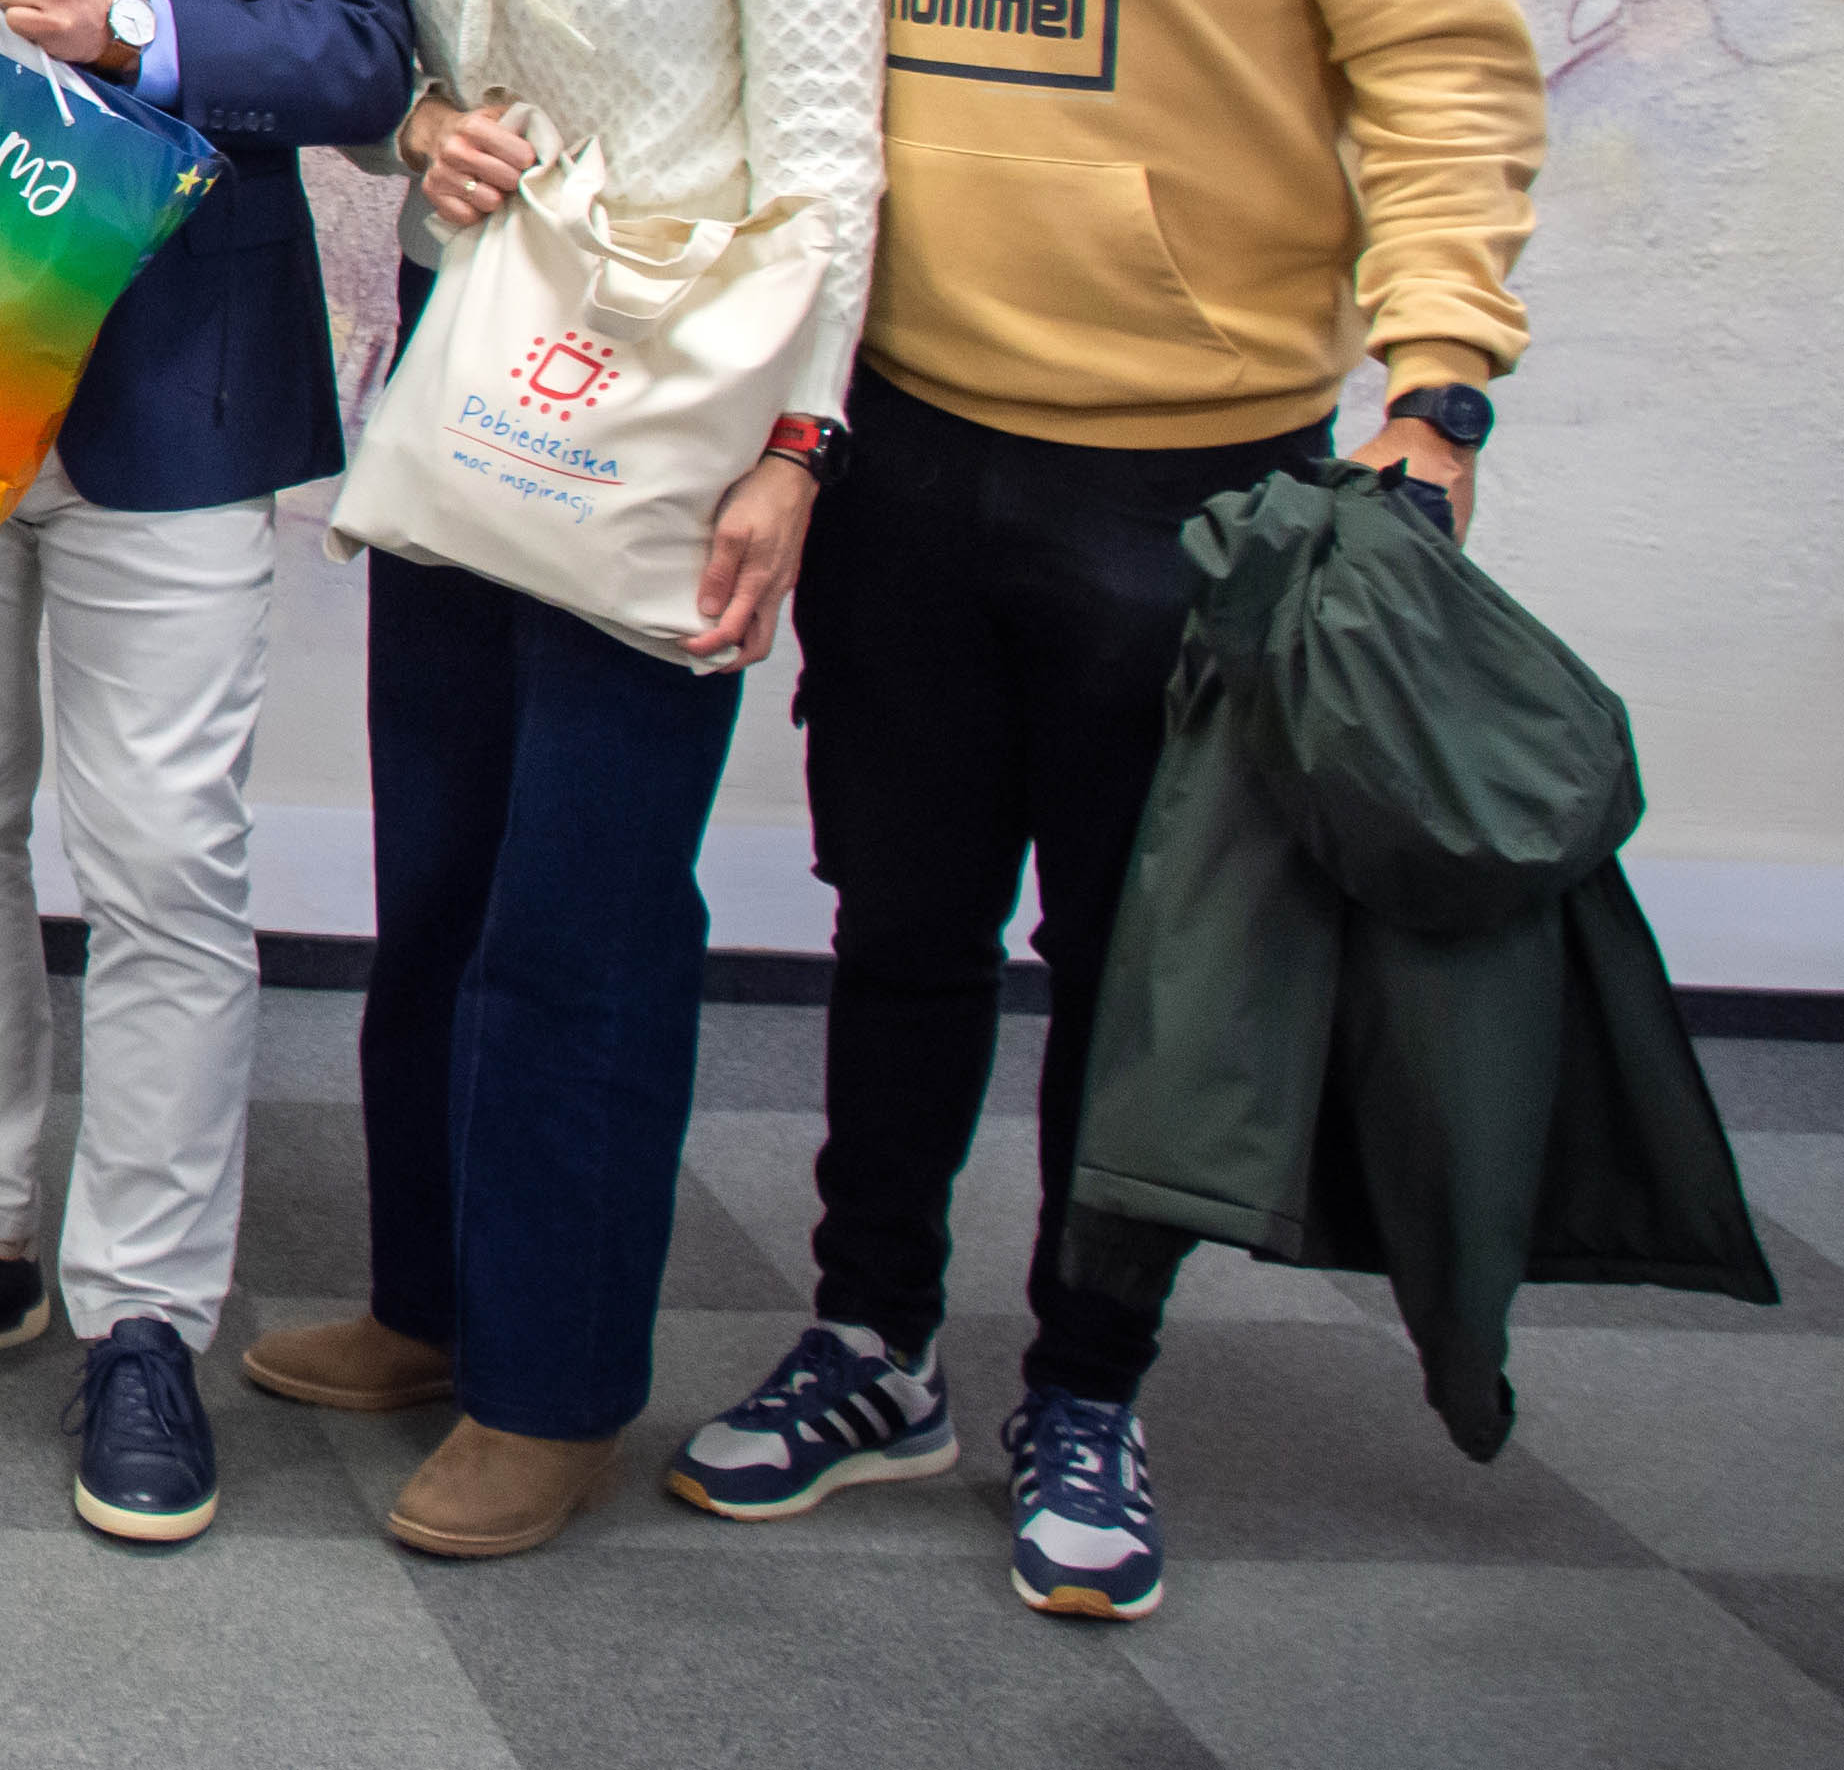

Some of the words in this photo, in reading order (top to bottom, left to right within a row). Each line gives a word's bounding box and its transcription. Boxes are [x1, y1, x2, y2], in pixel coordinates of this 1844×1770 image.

[457, 393, 619, 479] Pobiedziska
[452, 448, 494, 476] moc
[498, 462, 596, 525] inspiracji
